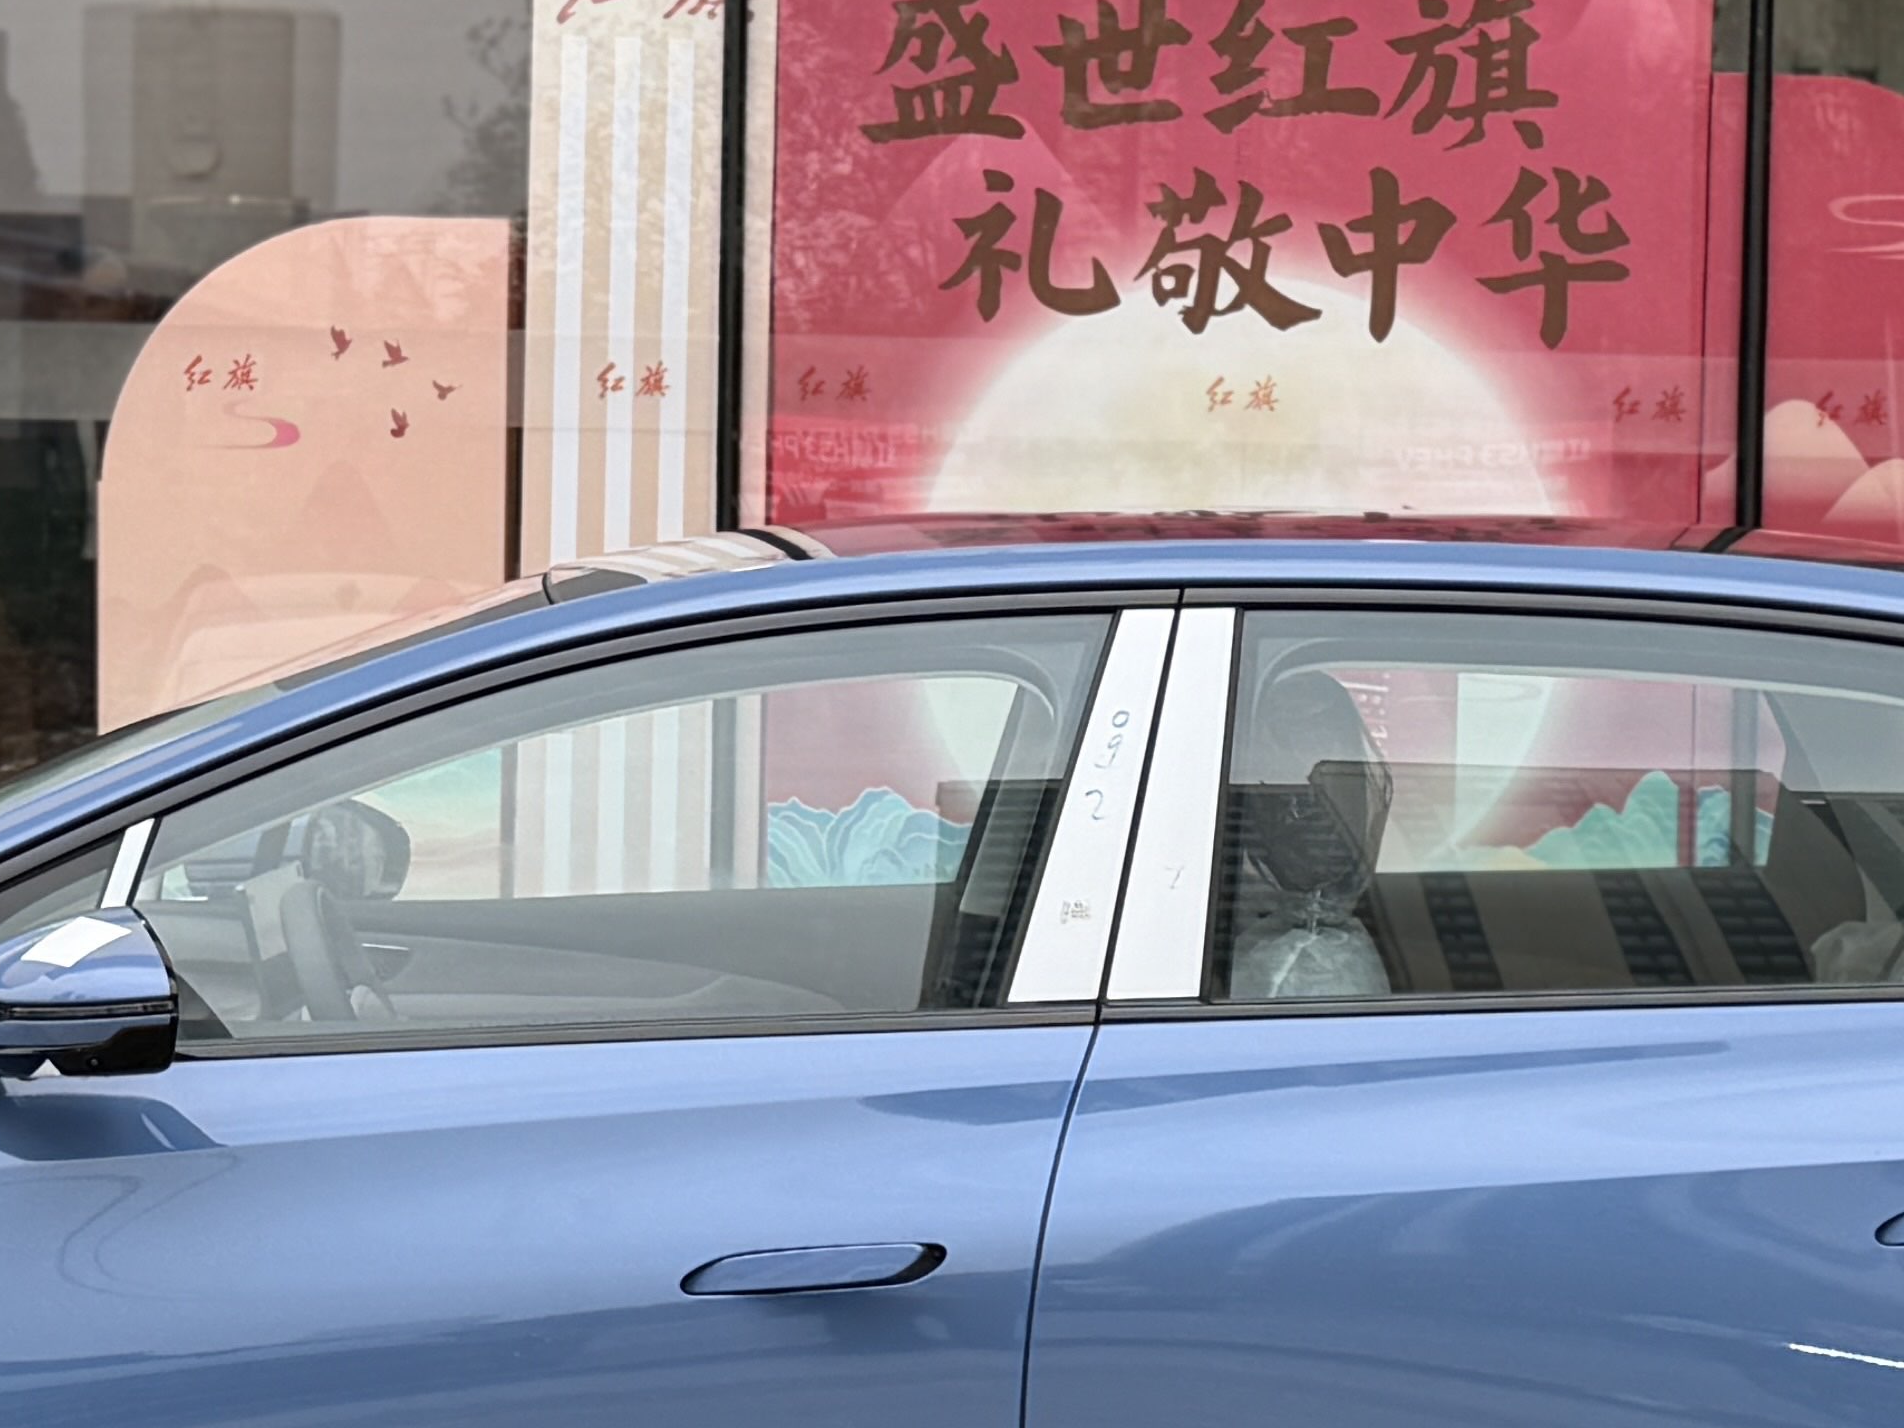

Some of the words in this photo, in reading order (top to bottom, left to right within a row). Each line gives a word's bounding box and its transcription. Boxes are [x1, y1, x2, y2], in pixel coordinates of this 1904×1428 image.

[939, 166, 1632, 351] 礼敬中华
[183, 352, 259, 391] 红旗
[596, 361, 671, 398] 红旗
[797, 365, 872, 404] 红旗
[1205, 375, 1280, 413] 红旗
[1613, 385, 1689, 423] 红旗
[1814, 389, 1889, 429] 红旗
